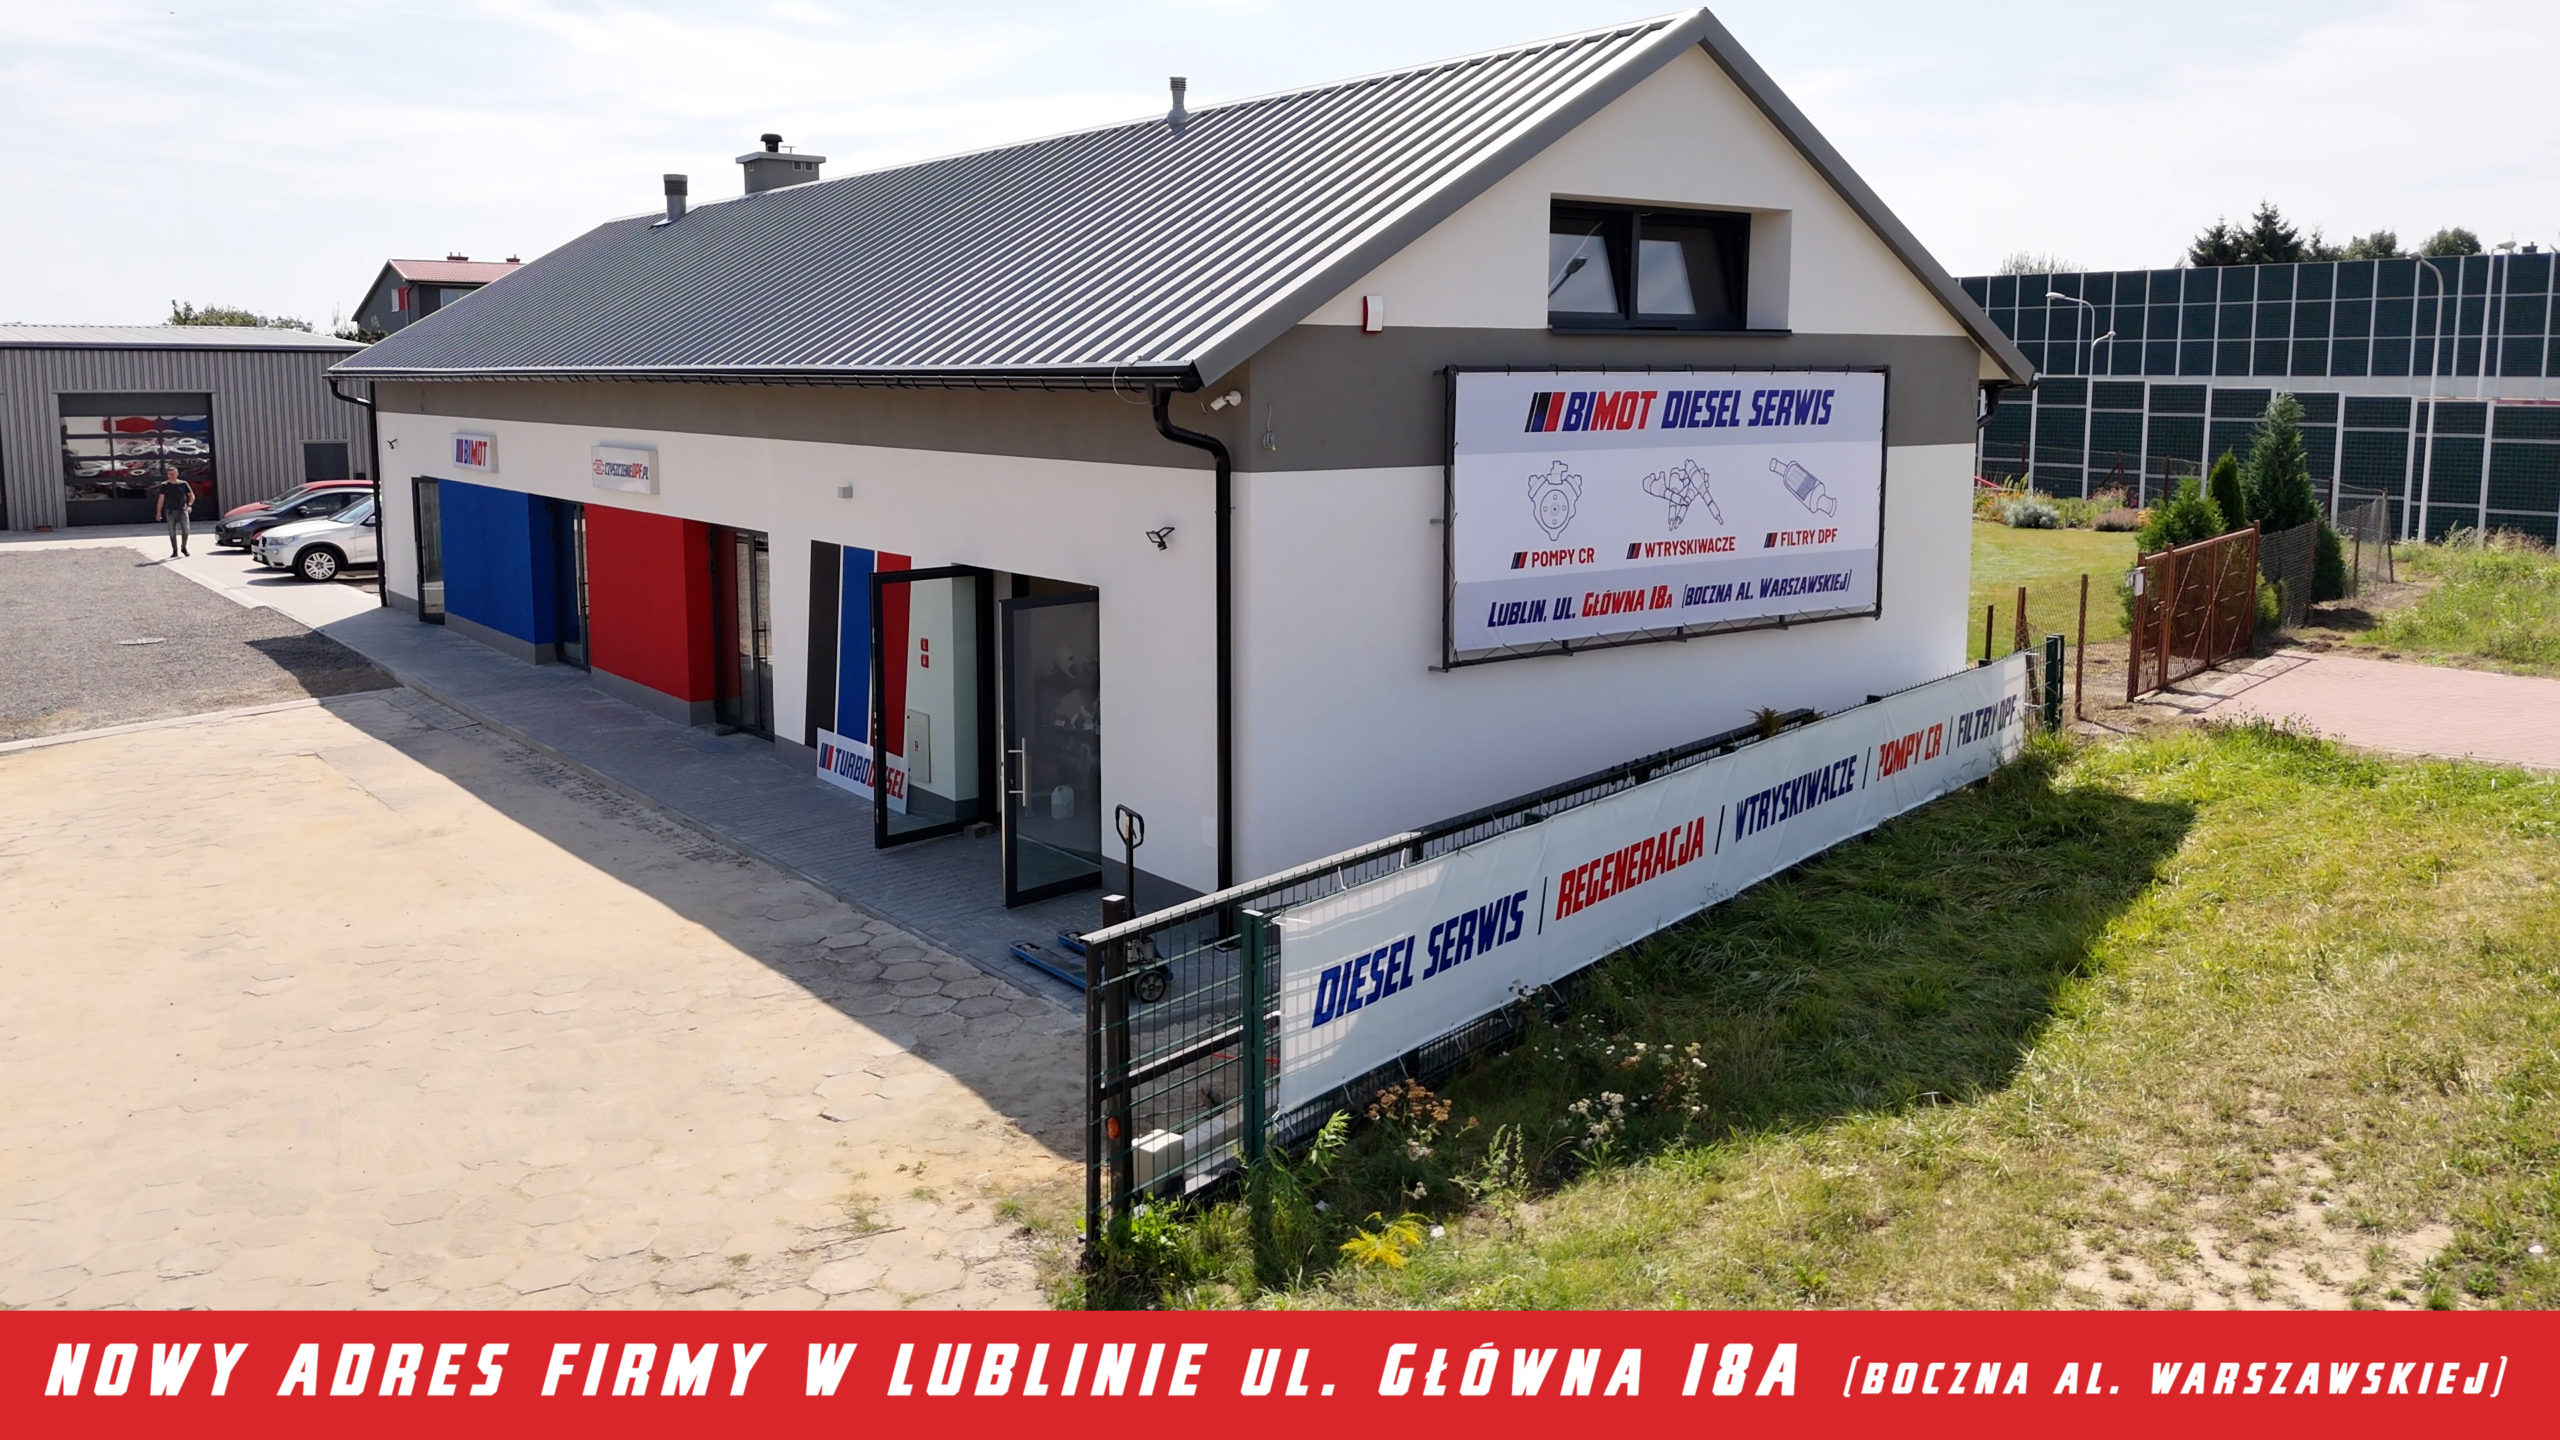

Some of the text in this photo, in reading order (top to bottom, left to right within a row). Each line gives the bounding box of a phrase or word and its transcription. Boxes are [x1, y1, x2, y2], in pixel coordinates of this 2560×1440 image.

[1562, 389, 1835, 431] BIMOT DIESEL SERWIS
[464, 438, 488, 467] BIMOT
[1644, 537, 1736, 558] WTRYSKIWACZE
[1780, 528, 1838, 547] FILTRY DPF
[1531, 548, 1595, 568] POMPY CR
[1582, 589, 1645, 618] GŁÓWNA
[1735, 581, 1754, 601] AL.
[834, 747, 905, 800] TURBODSEL
[1312, 694, 2017, 1028] DIESEL SERWIS REGENERACJA WTRYSKIWACZE POMPY CR FILTRY DPF
